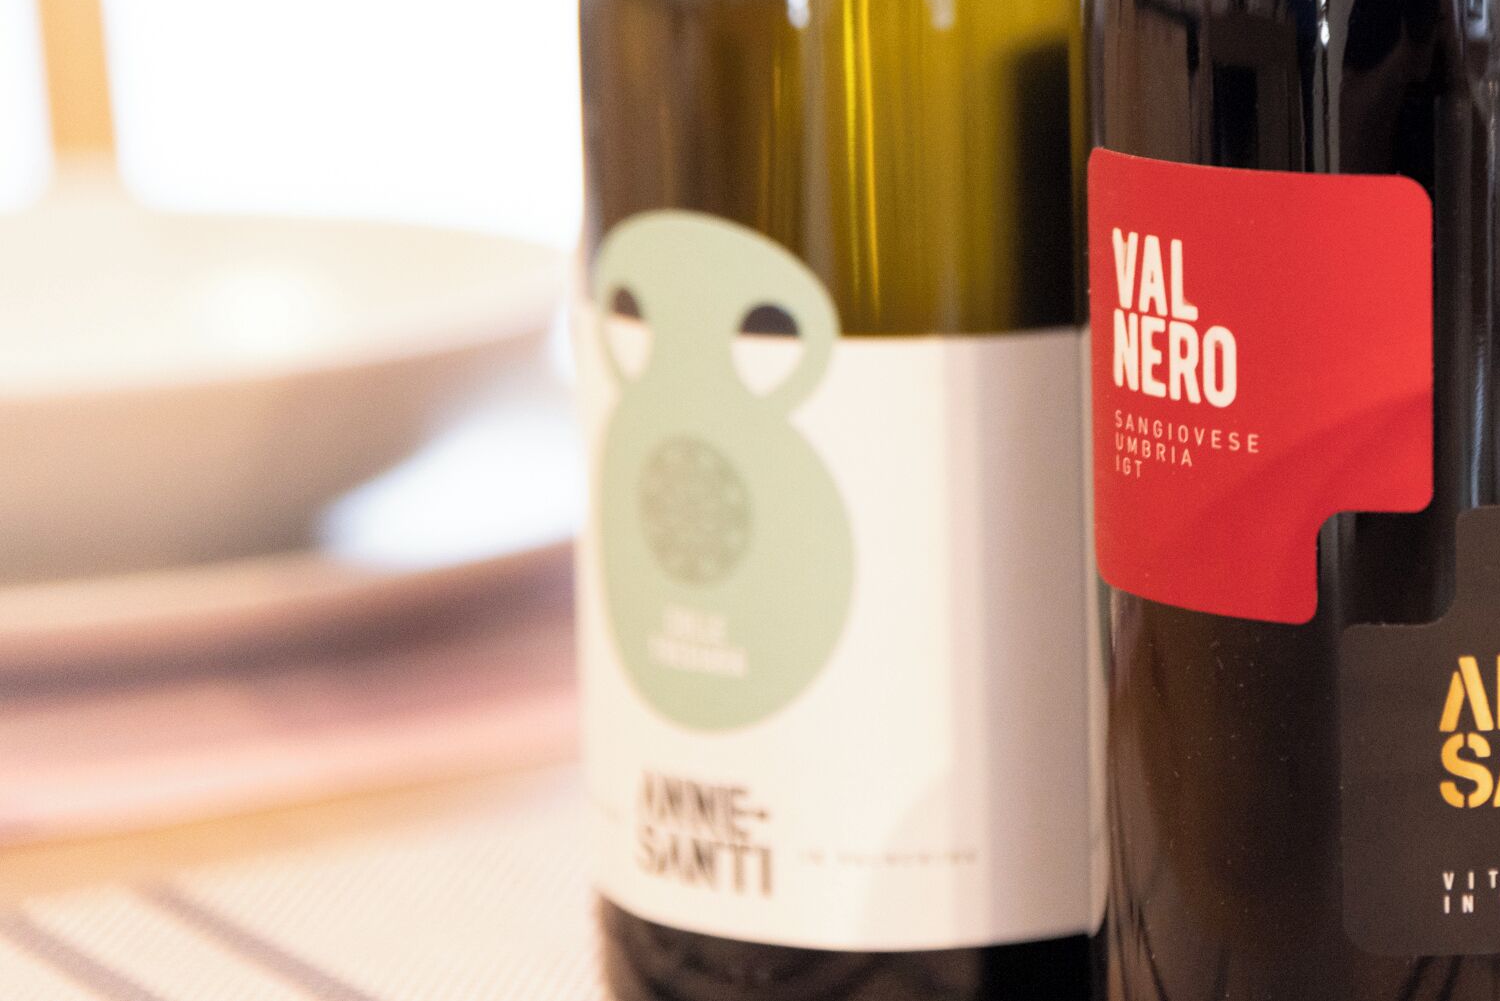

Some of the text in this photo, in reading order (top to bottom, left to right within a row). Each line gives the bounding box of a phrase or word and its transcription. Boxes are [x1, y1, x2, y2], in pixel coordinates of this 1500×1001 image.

[1112, 227, 1199, 322] VAL
[1113, 308, 1238, 409] NERO
[1114, 410, 1260, 454] SANGIOVESE
[1115, 432, 1193, 468] UMBRIA
[1115, 455, 1143, 479] IGT
[1443, 895, 1475, 914] IN
